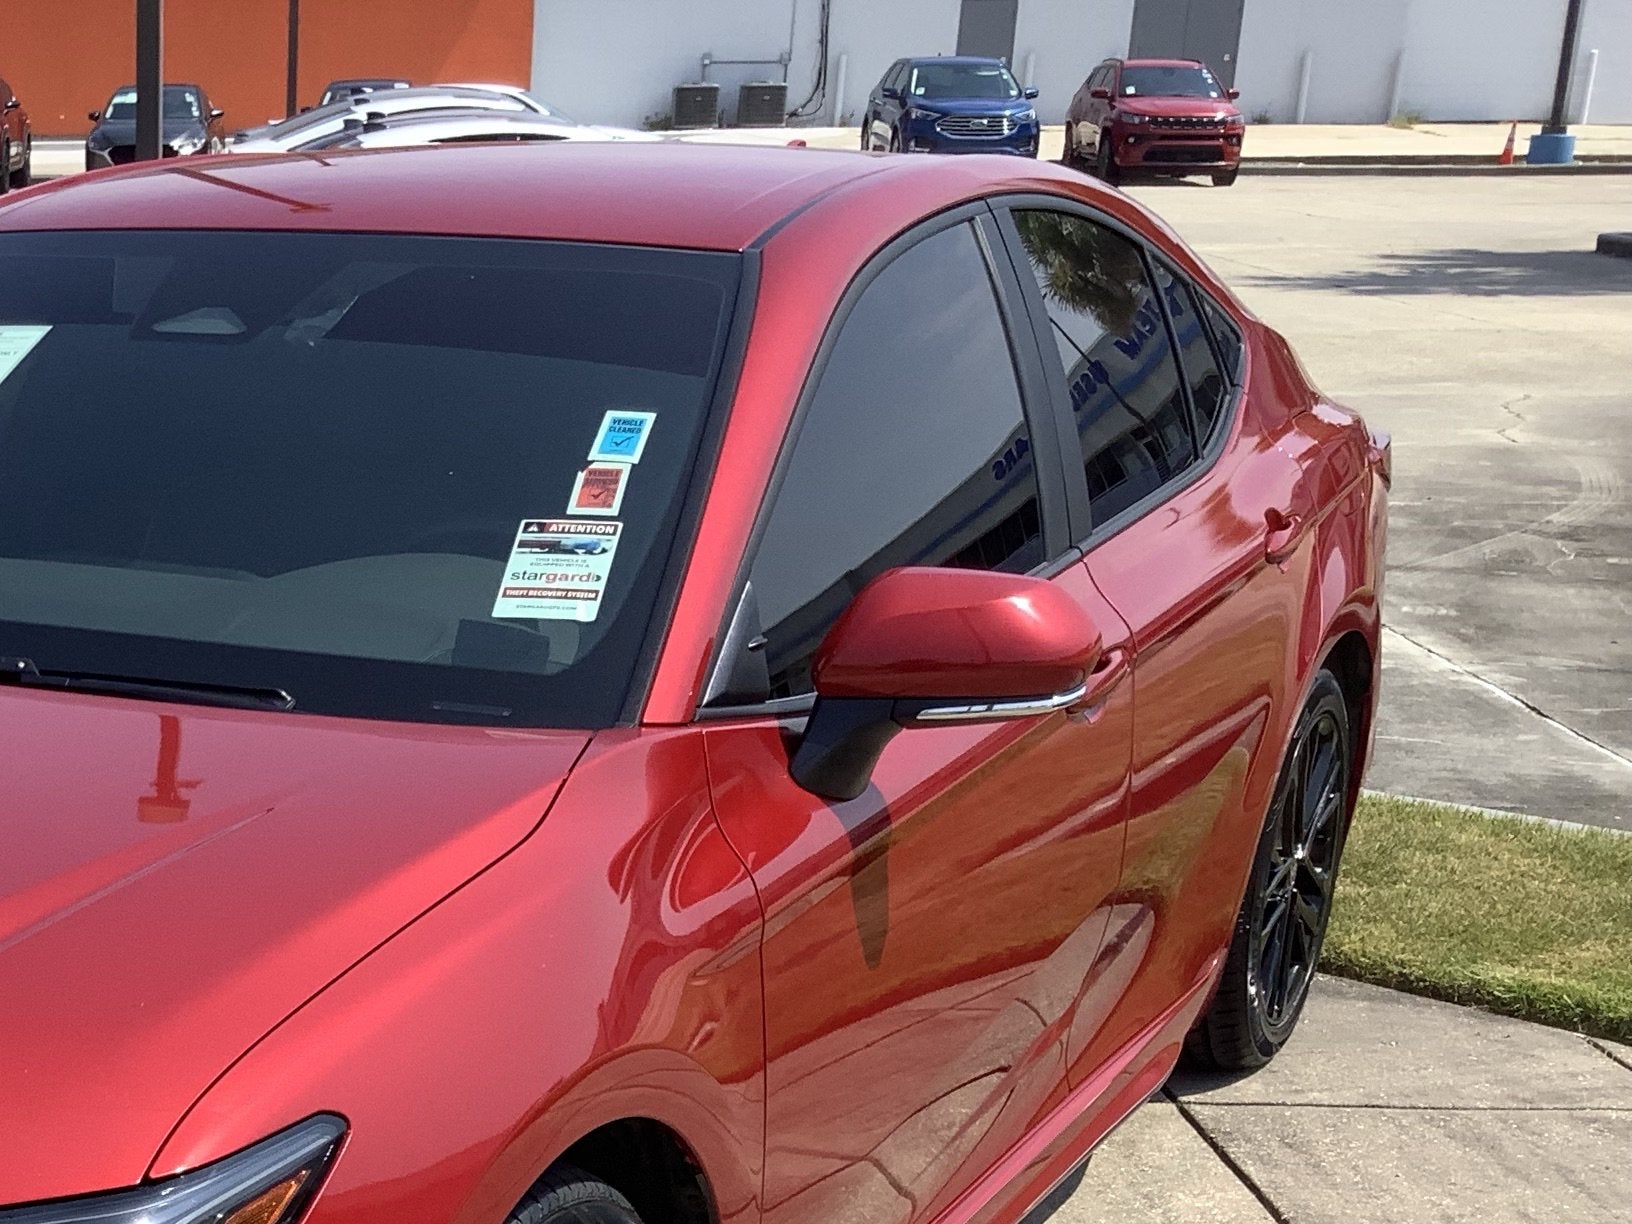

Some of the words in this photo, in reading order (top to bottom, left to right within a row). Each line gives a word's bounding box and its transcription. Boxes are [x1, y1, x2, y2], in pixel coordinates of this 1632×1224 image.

[612, 418, 644, 427] VEHICLE
[549, 523, 615, 534] ATTENTION
[567, 591, 597, 599] SYSTEM
